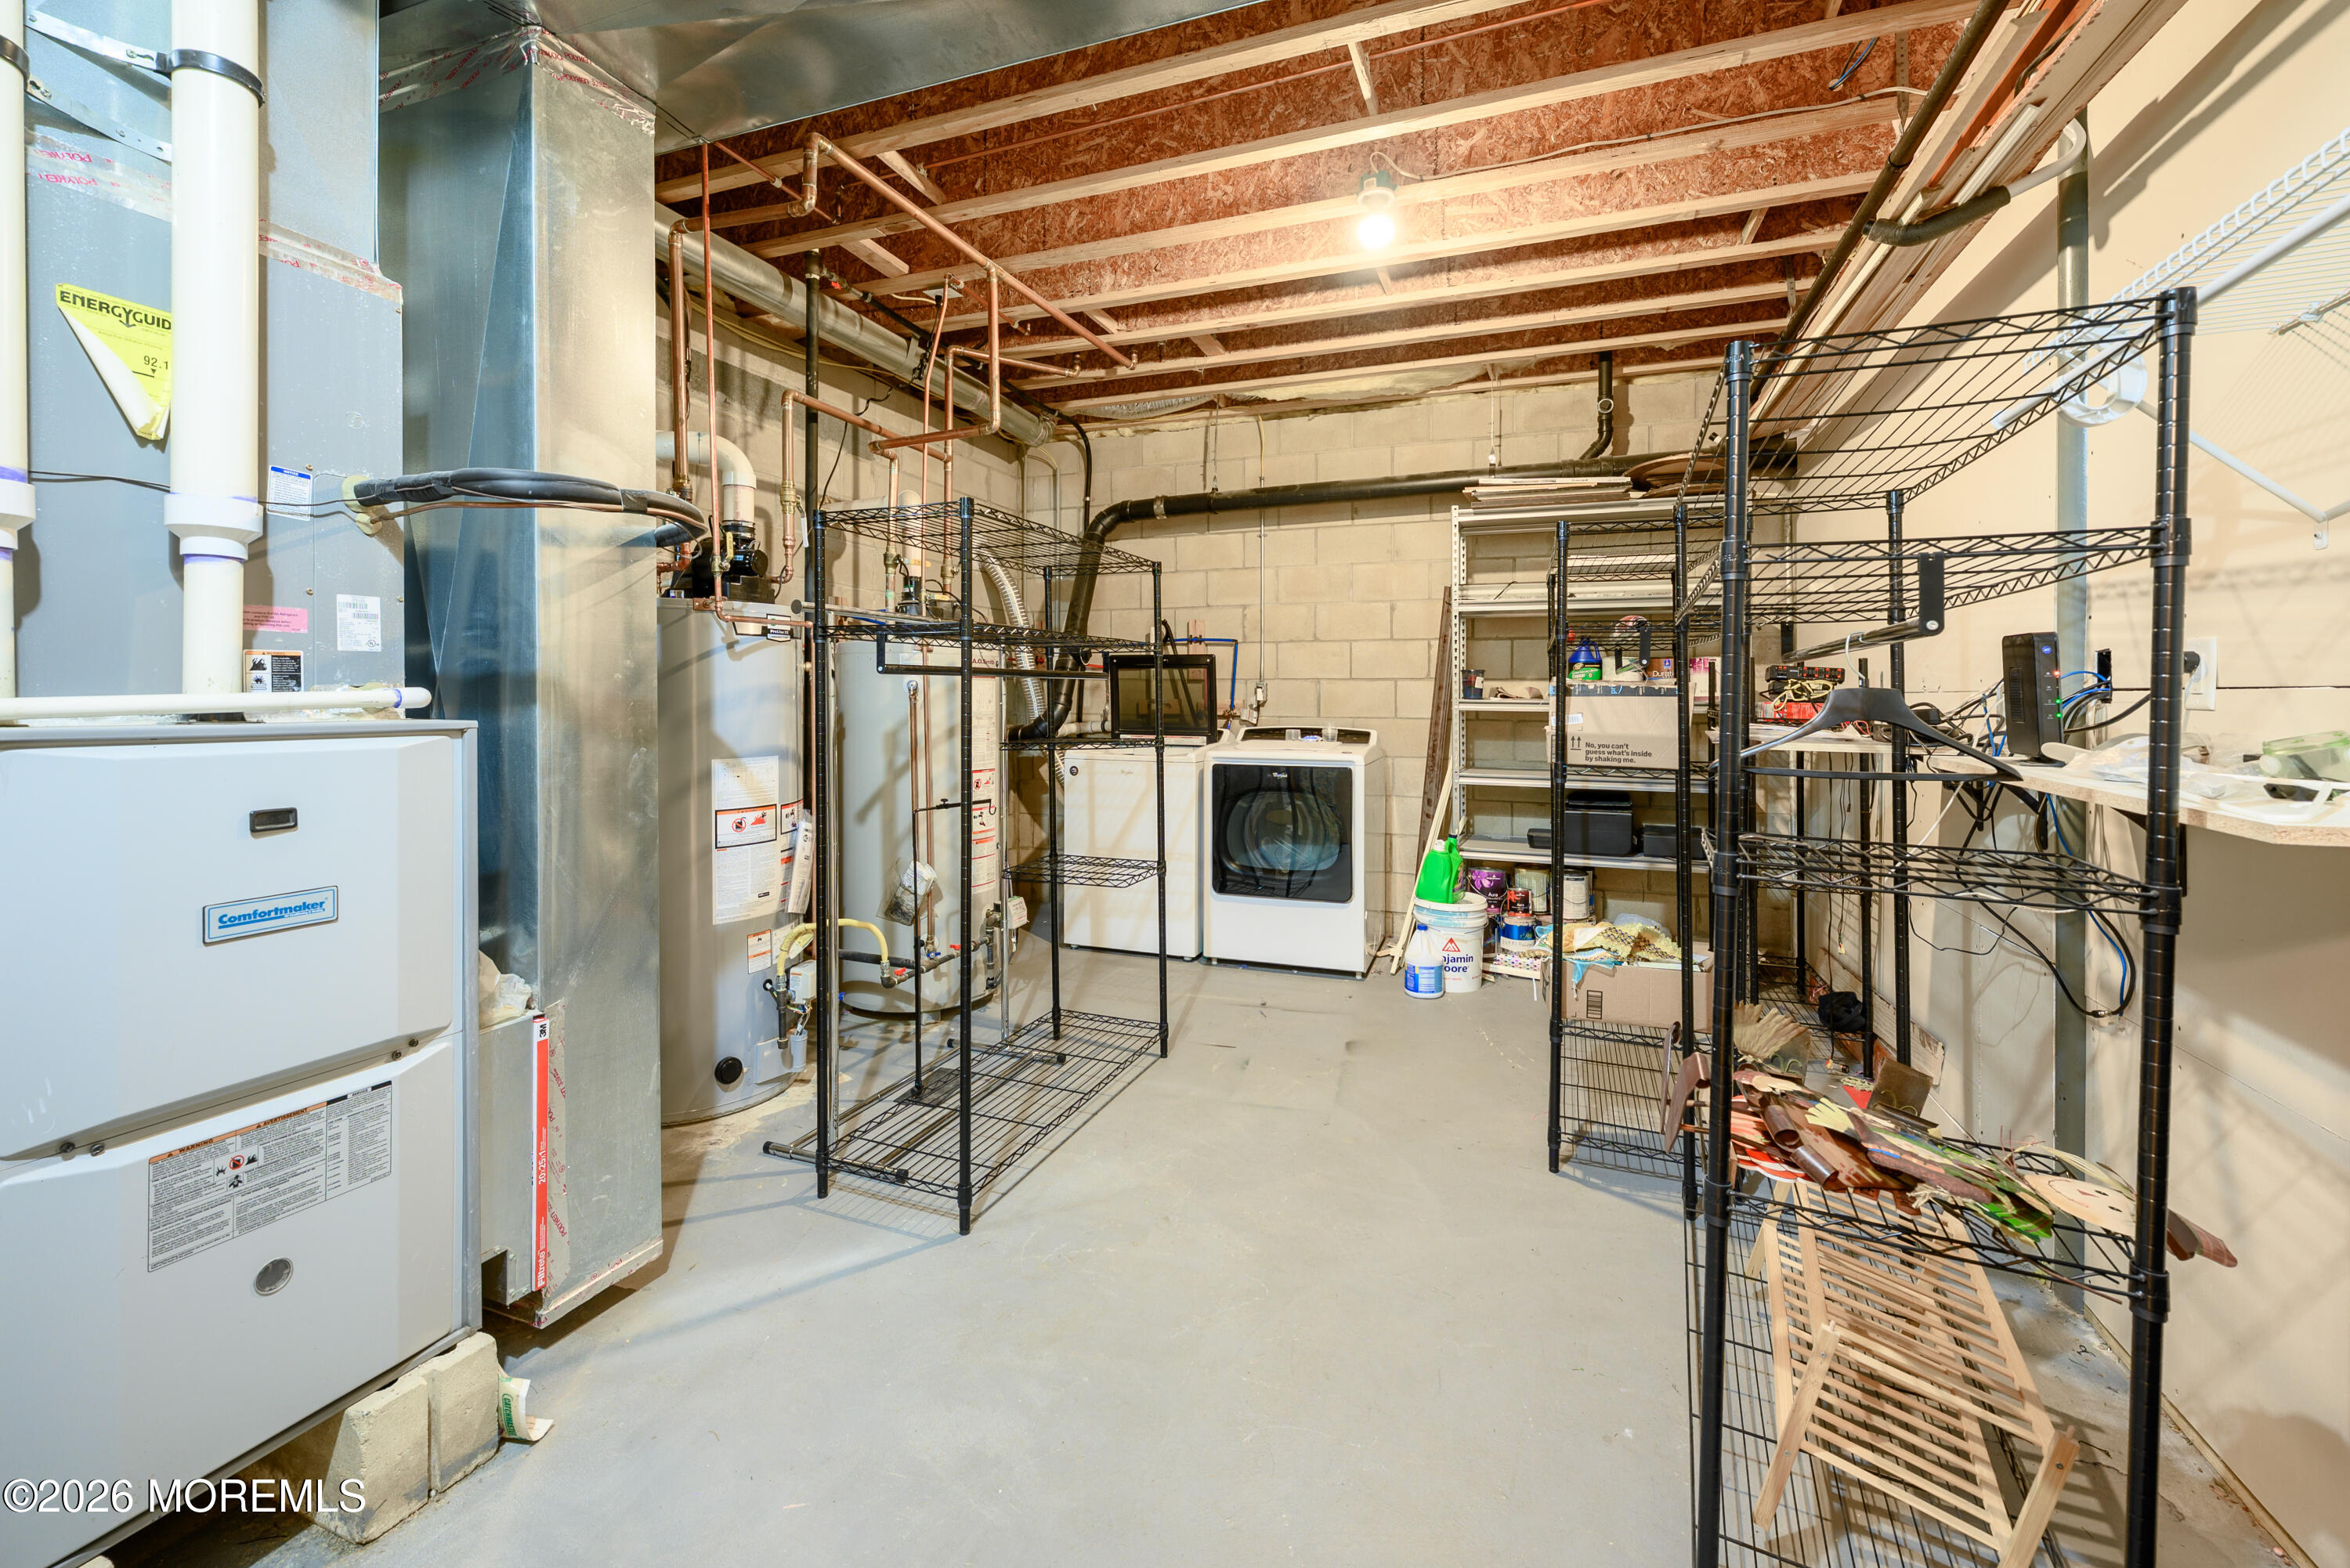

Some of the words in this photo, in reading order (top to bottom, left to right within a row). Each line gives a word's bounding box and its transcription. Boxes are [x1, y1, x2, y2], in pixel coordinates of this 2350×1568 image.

[60, 290, 172, 330] ENERGYGUID
[143, 355, 168, 370] 92.1
[218, 901, 326, 924] Comfortmaker
[1442, 954, 1473, 964] njamin
[539, 1023, 547, 1038] 3M
[263, 1107, 308, 1127] AVERTISSEMENT
[179, 1139, 214, 1154] WARNING
[537, 1251, 547, 1288] Filtrete
[504, 1397, 517, 1436] CATCHMASTE
